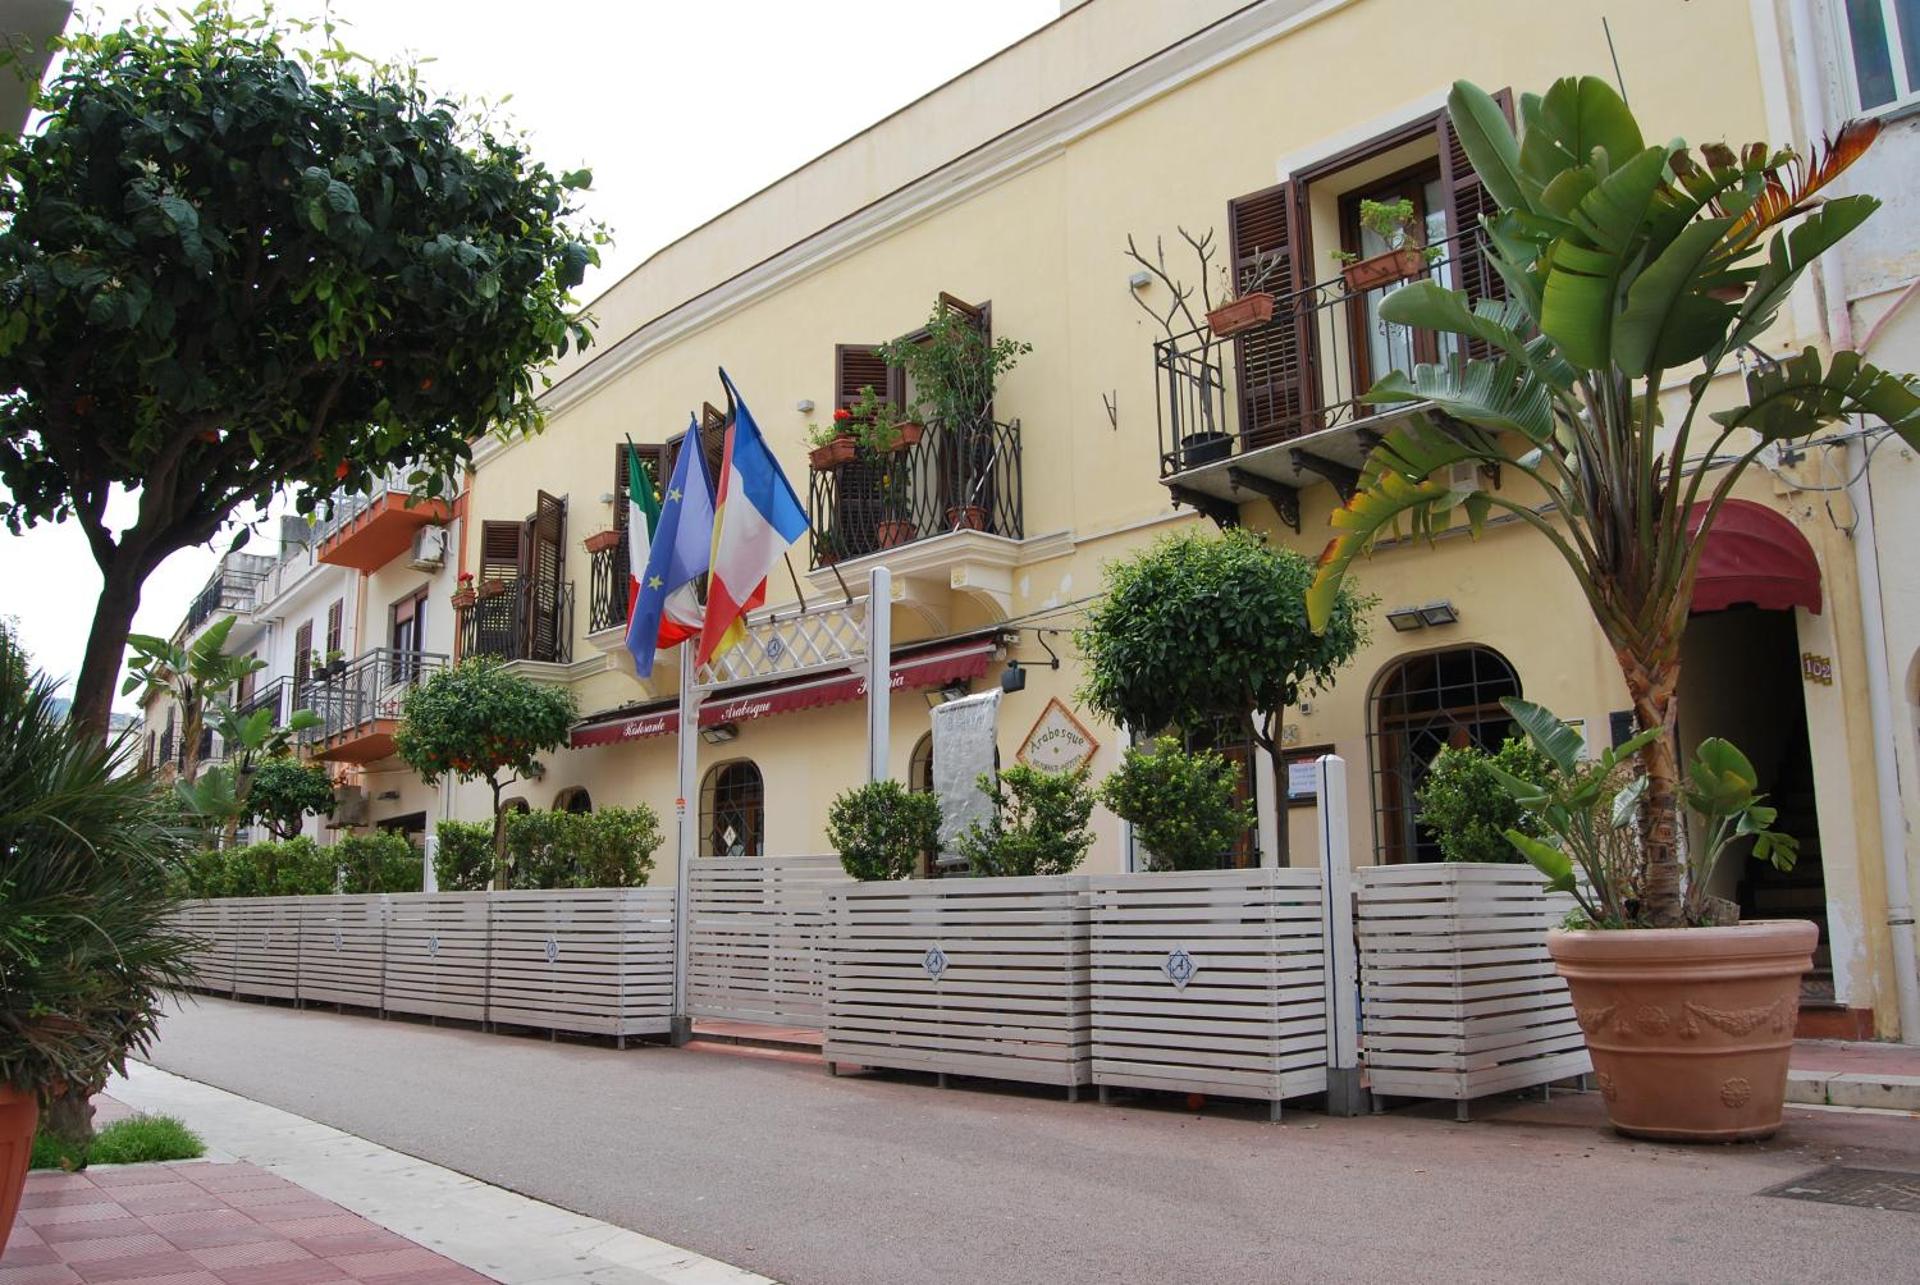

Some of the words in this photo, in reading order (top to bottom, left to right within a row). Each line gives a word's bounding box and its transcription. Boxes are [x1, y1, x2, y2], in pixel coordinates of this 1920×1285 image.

[1805, 659, 1832, 678] 102
[622, 717, 666, 737] Ristorante
[721, 700, 771, 720] Arabesque
[1030, 727, 1085, 754] Arabesque
